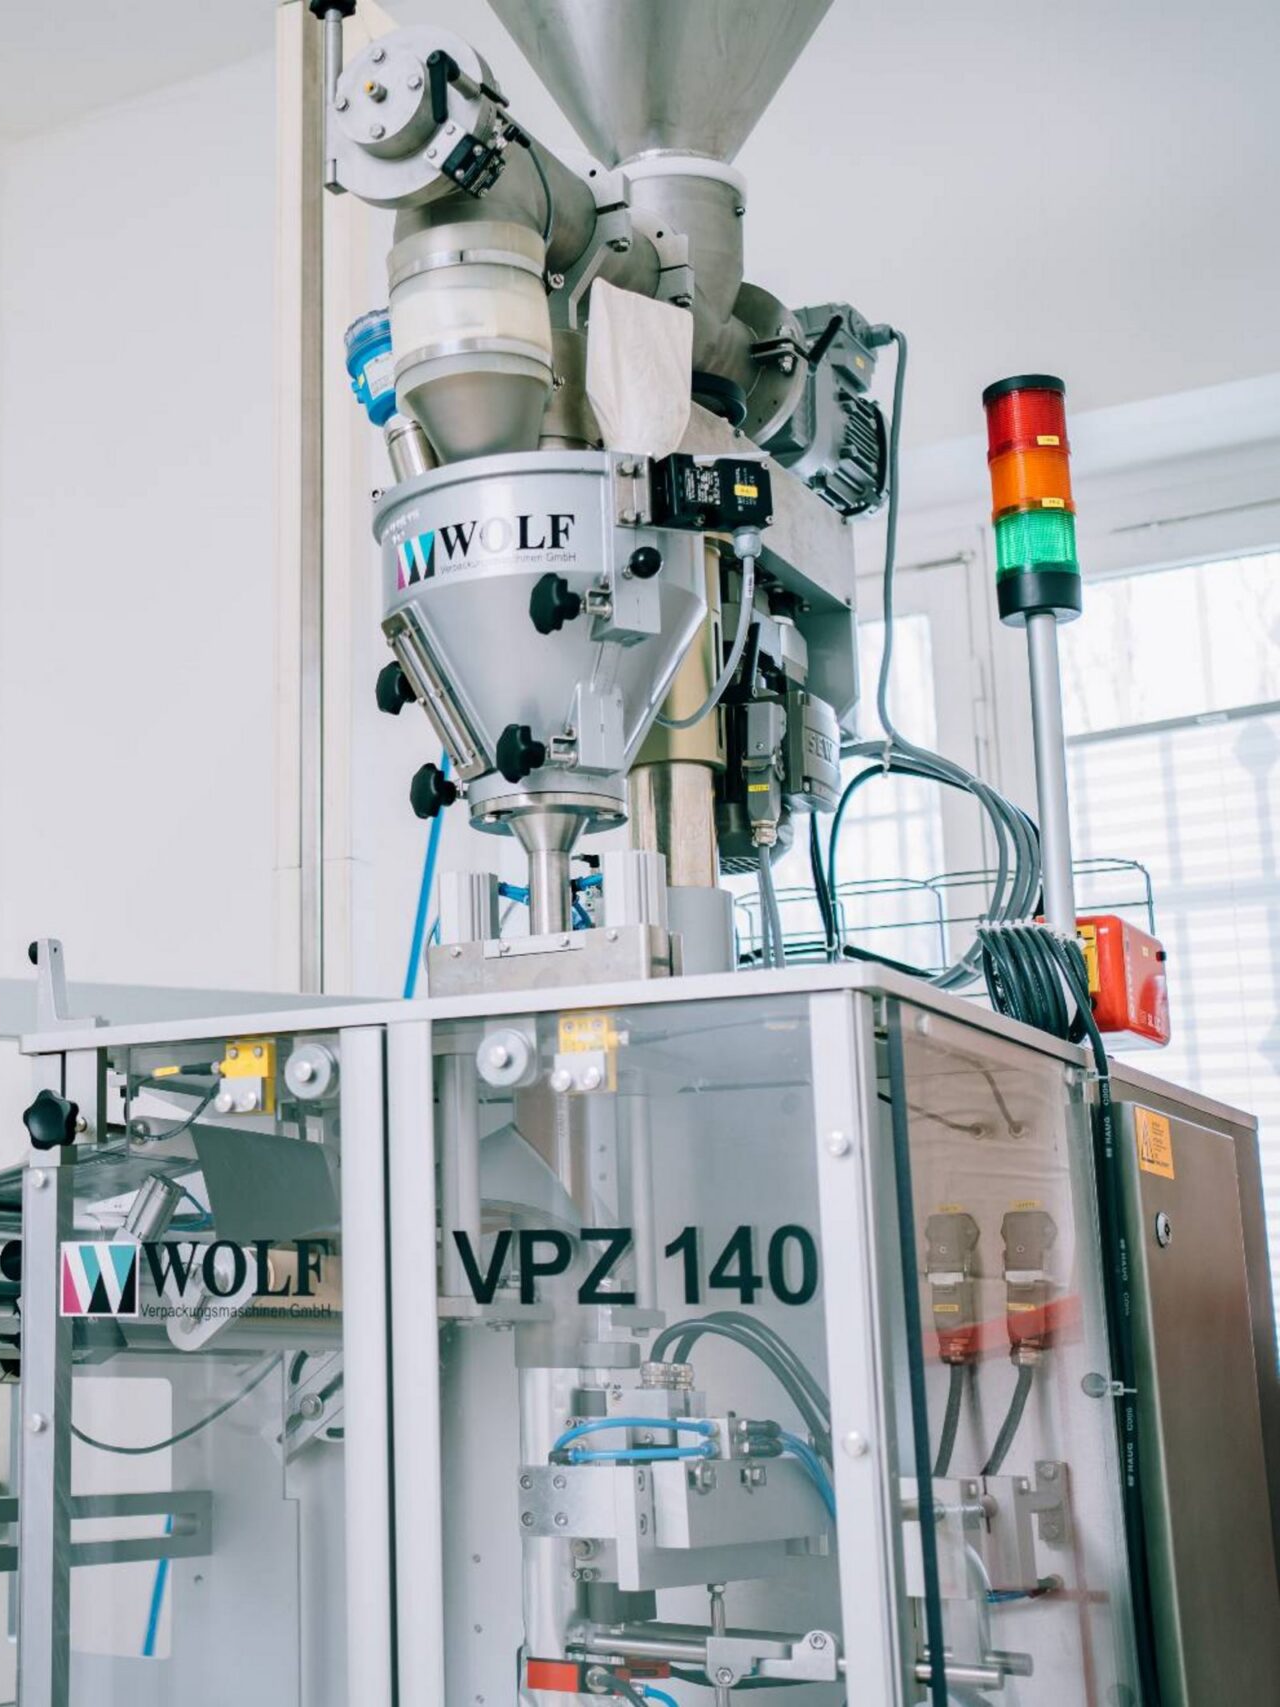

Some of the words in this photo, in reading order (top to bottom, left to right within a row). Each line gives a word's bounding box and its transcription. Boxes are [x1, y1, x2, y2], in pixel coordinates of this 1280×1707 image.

[438, 513, 575, 560] WOLF
[141, 1239, 329, 1298] WOLF
[452, 1227, 636, 1305] VPZ
[665, 1224, 819, 1306] 140
[140, 1303, 286, 1321] Verpackungsmaschinen
[290, 1302, 331, 1318] GmbH
